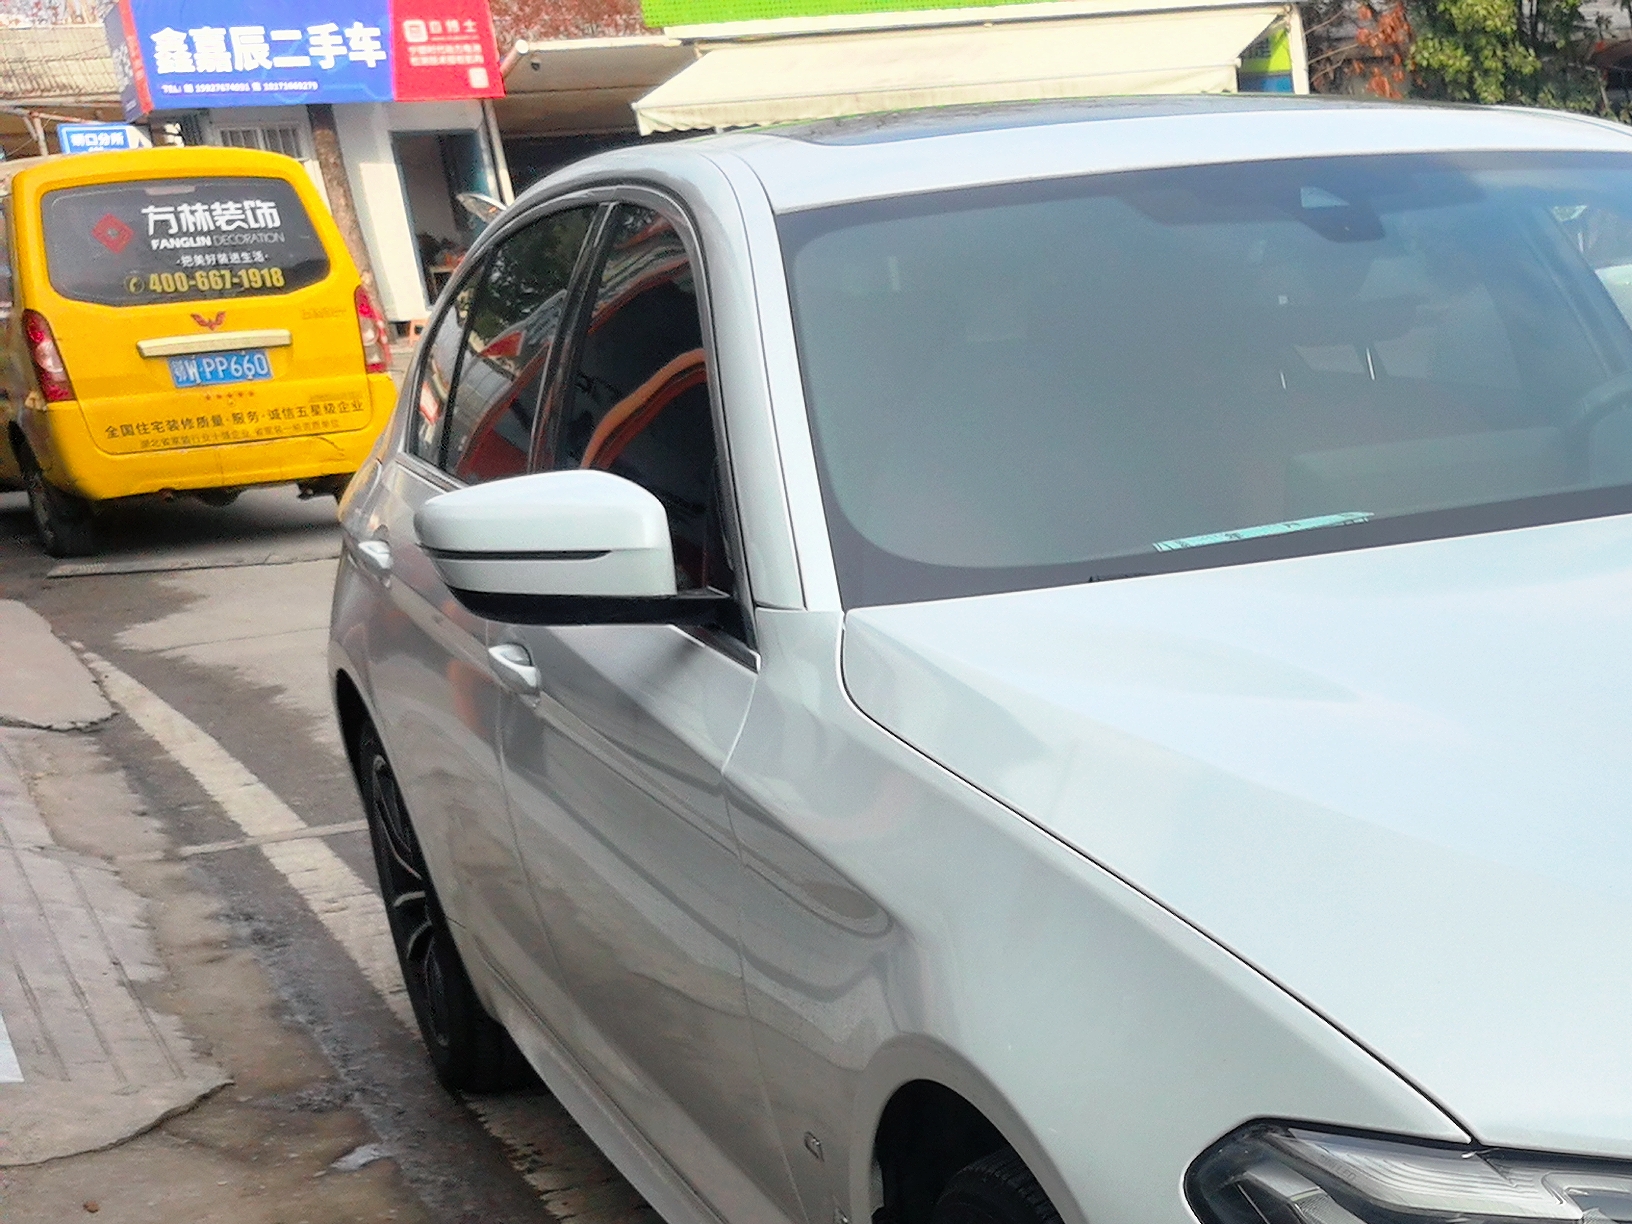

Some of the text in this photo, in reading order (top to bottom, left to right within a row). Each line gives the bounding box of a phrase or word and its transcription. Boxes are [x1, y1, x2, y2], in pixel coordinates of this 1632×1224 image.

[150, 21, 387, 74] 鑫嘉辰二手车
[141, 199, 281, 236] 方林装饰
[151, 231, 286, 250] FANGLIN DECORATION
[149, 267, 286, 294] 400-667-1918
